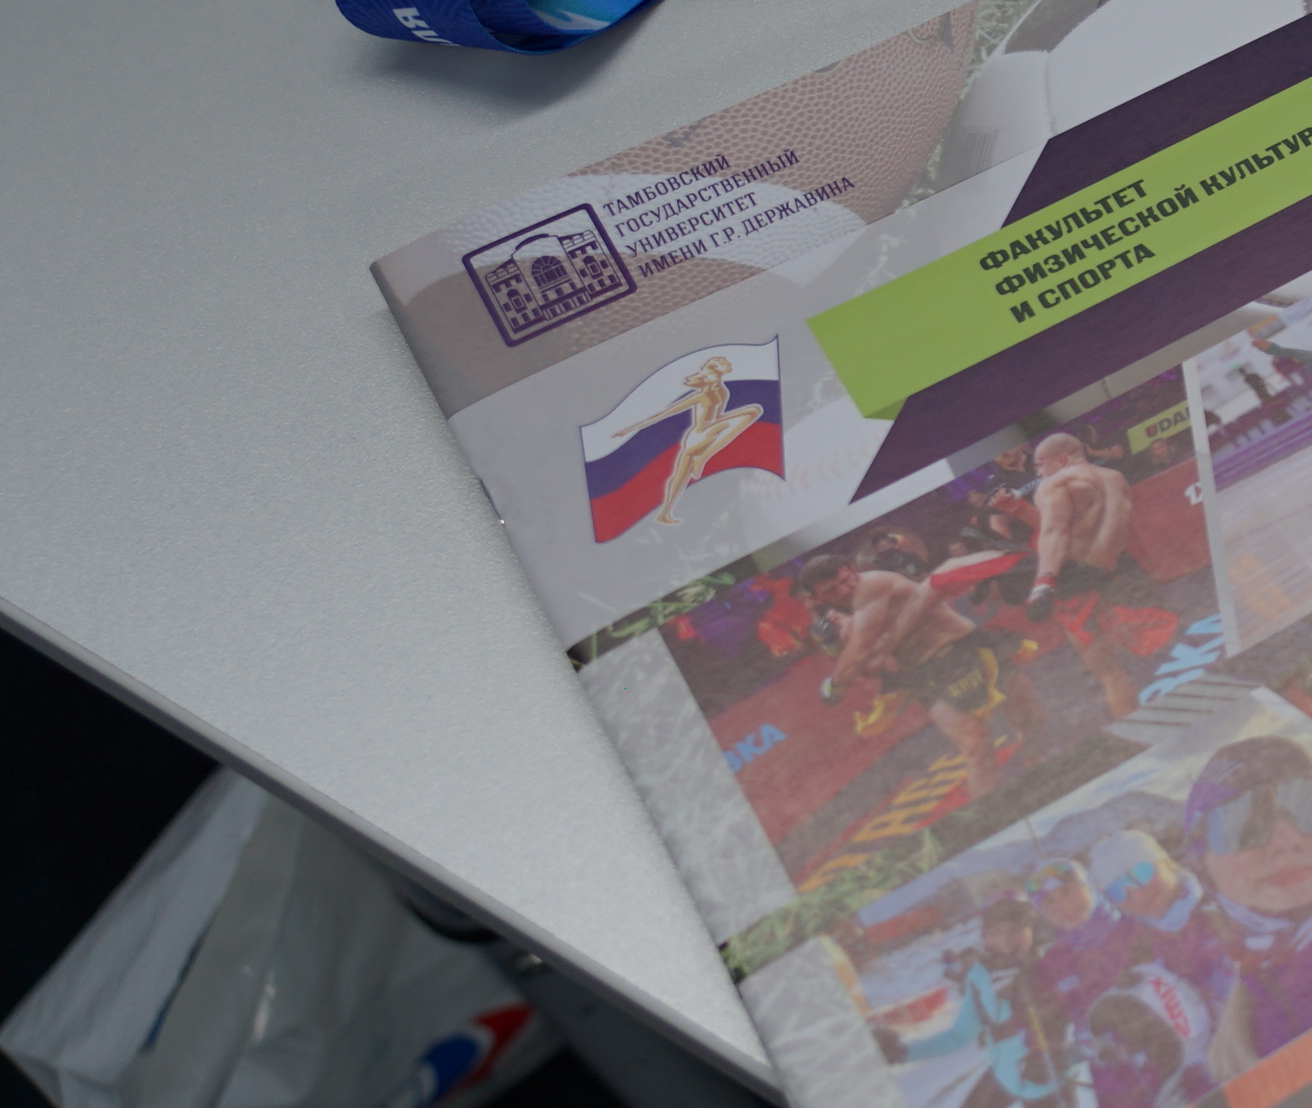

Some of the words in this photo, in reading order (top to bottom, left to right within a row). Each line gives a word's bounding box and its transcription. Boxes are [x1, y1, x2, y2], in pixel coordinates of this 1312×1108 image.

[602, 152, 733, 218] ТАМБОВСКИЙ
[614, 148, 801, 238] ГОСУДАРСТВЕННЫЙ
[624, 191, 760, 259] УНИВЕРСИТЕТ
[637, 238, 709, 279] ИМЕНИ
[741, 175, 856, 237] ДЕРЖАВИНА
[978, 178, 1149, 273] ФАКУЛЬТЕТ
[994, 183, 1201, 298] ФИЗИЧЕСКОЙ
[1009, 300, 1037, 325] И
[1036, 242, 1157, 312] СПОРТА
